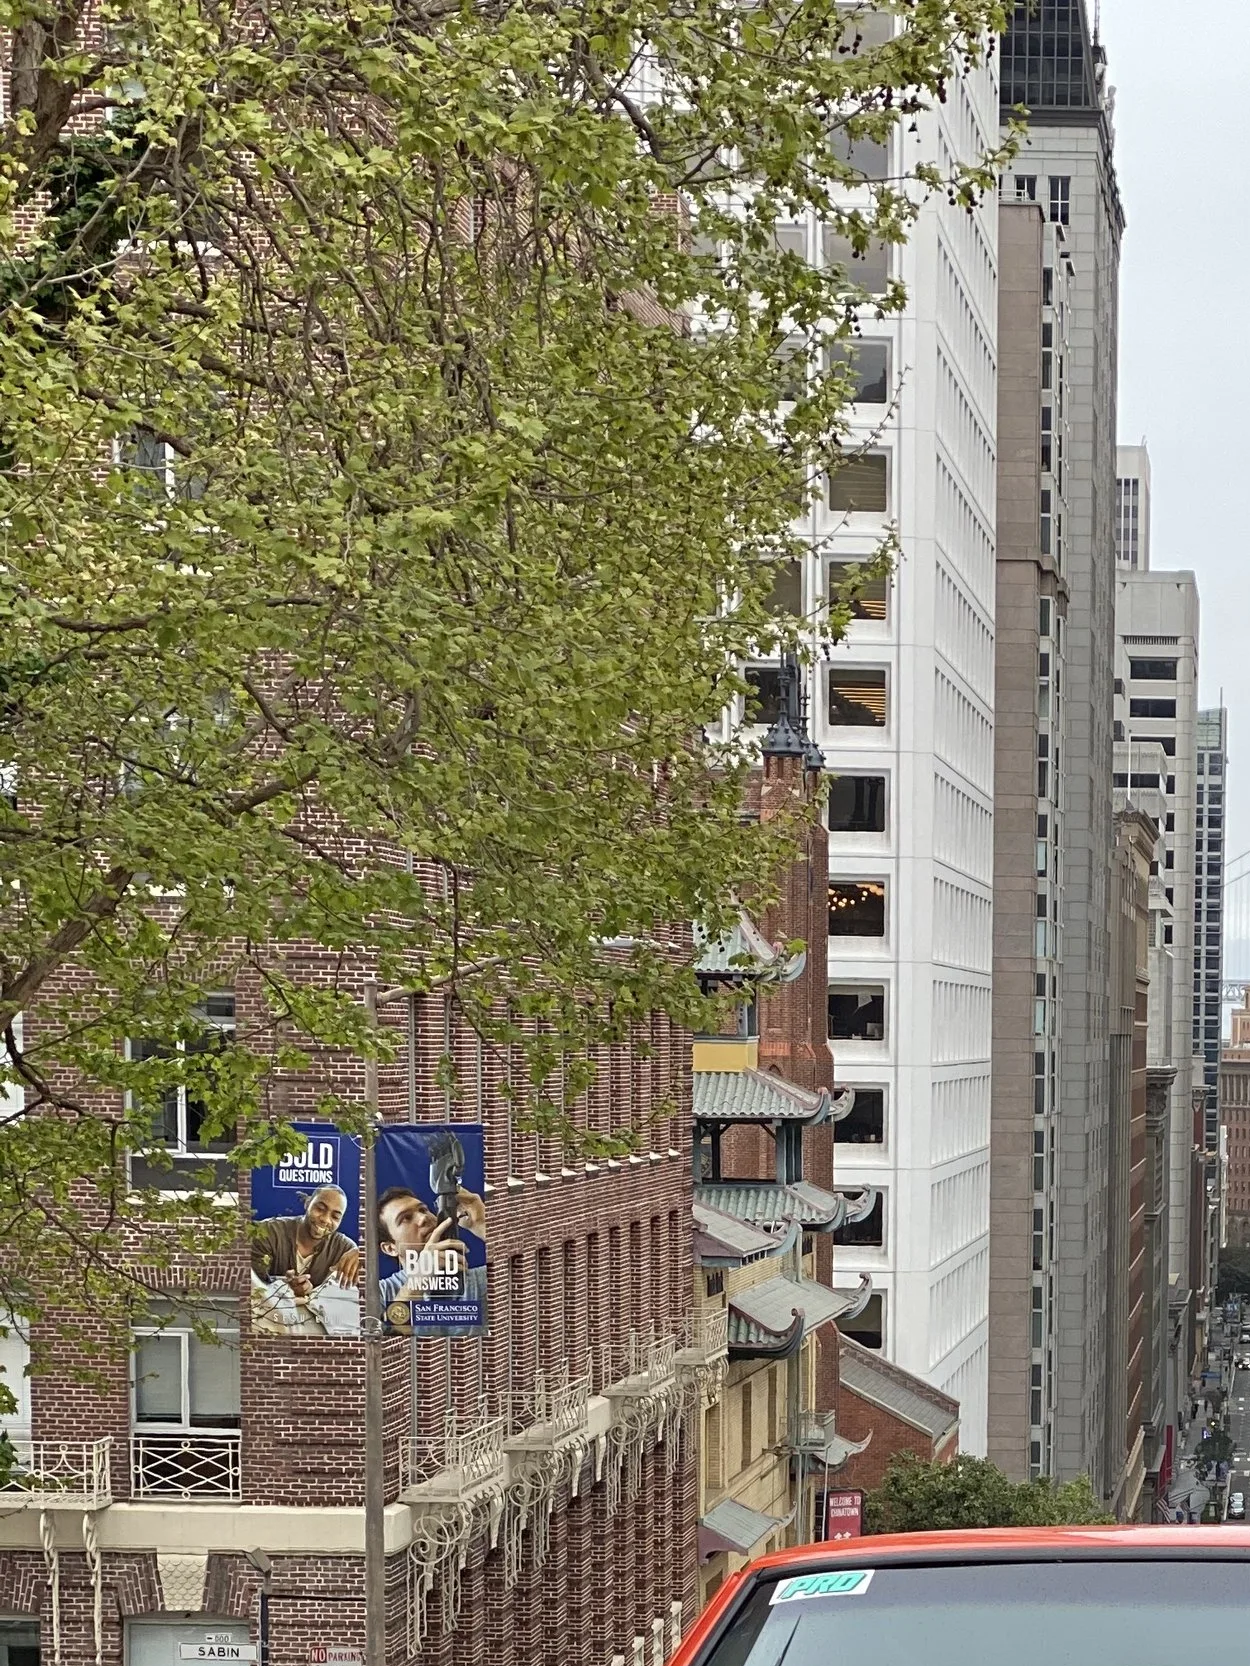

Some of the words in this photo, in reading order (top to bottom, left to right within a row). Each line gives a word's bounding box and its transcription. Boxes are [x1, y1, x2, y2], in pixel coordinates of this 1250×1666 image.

[279, 1169, 334, 1184] QUESTIONS
[405, 1249, 459, 1275] BOLD
[408, 1277, 460, 1291] ANSWERS
[415, 1304, 432, 1312] SAN
[434, 1304, 478, 1312] FRANCISCO
[777, 1573, 867, 1599] PRO
[198, 1646, 240, 1658] SABIN
[311, 1648, 326, 1662] NO
[328, 1652, 360, 1661] PARKING
